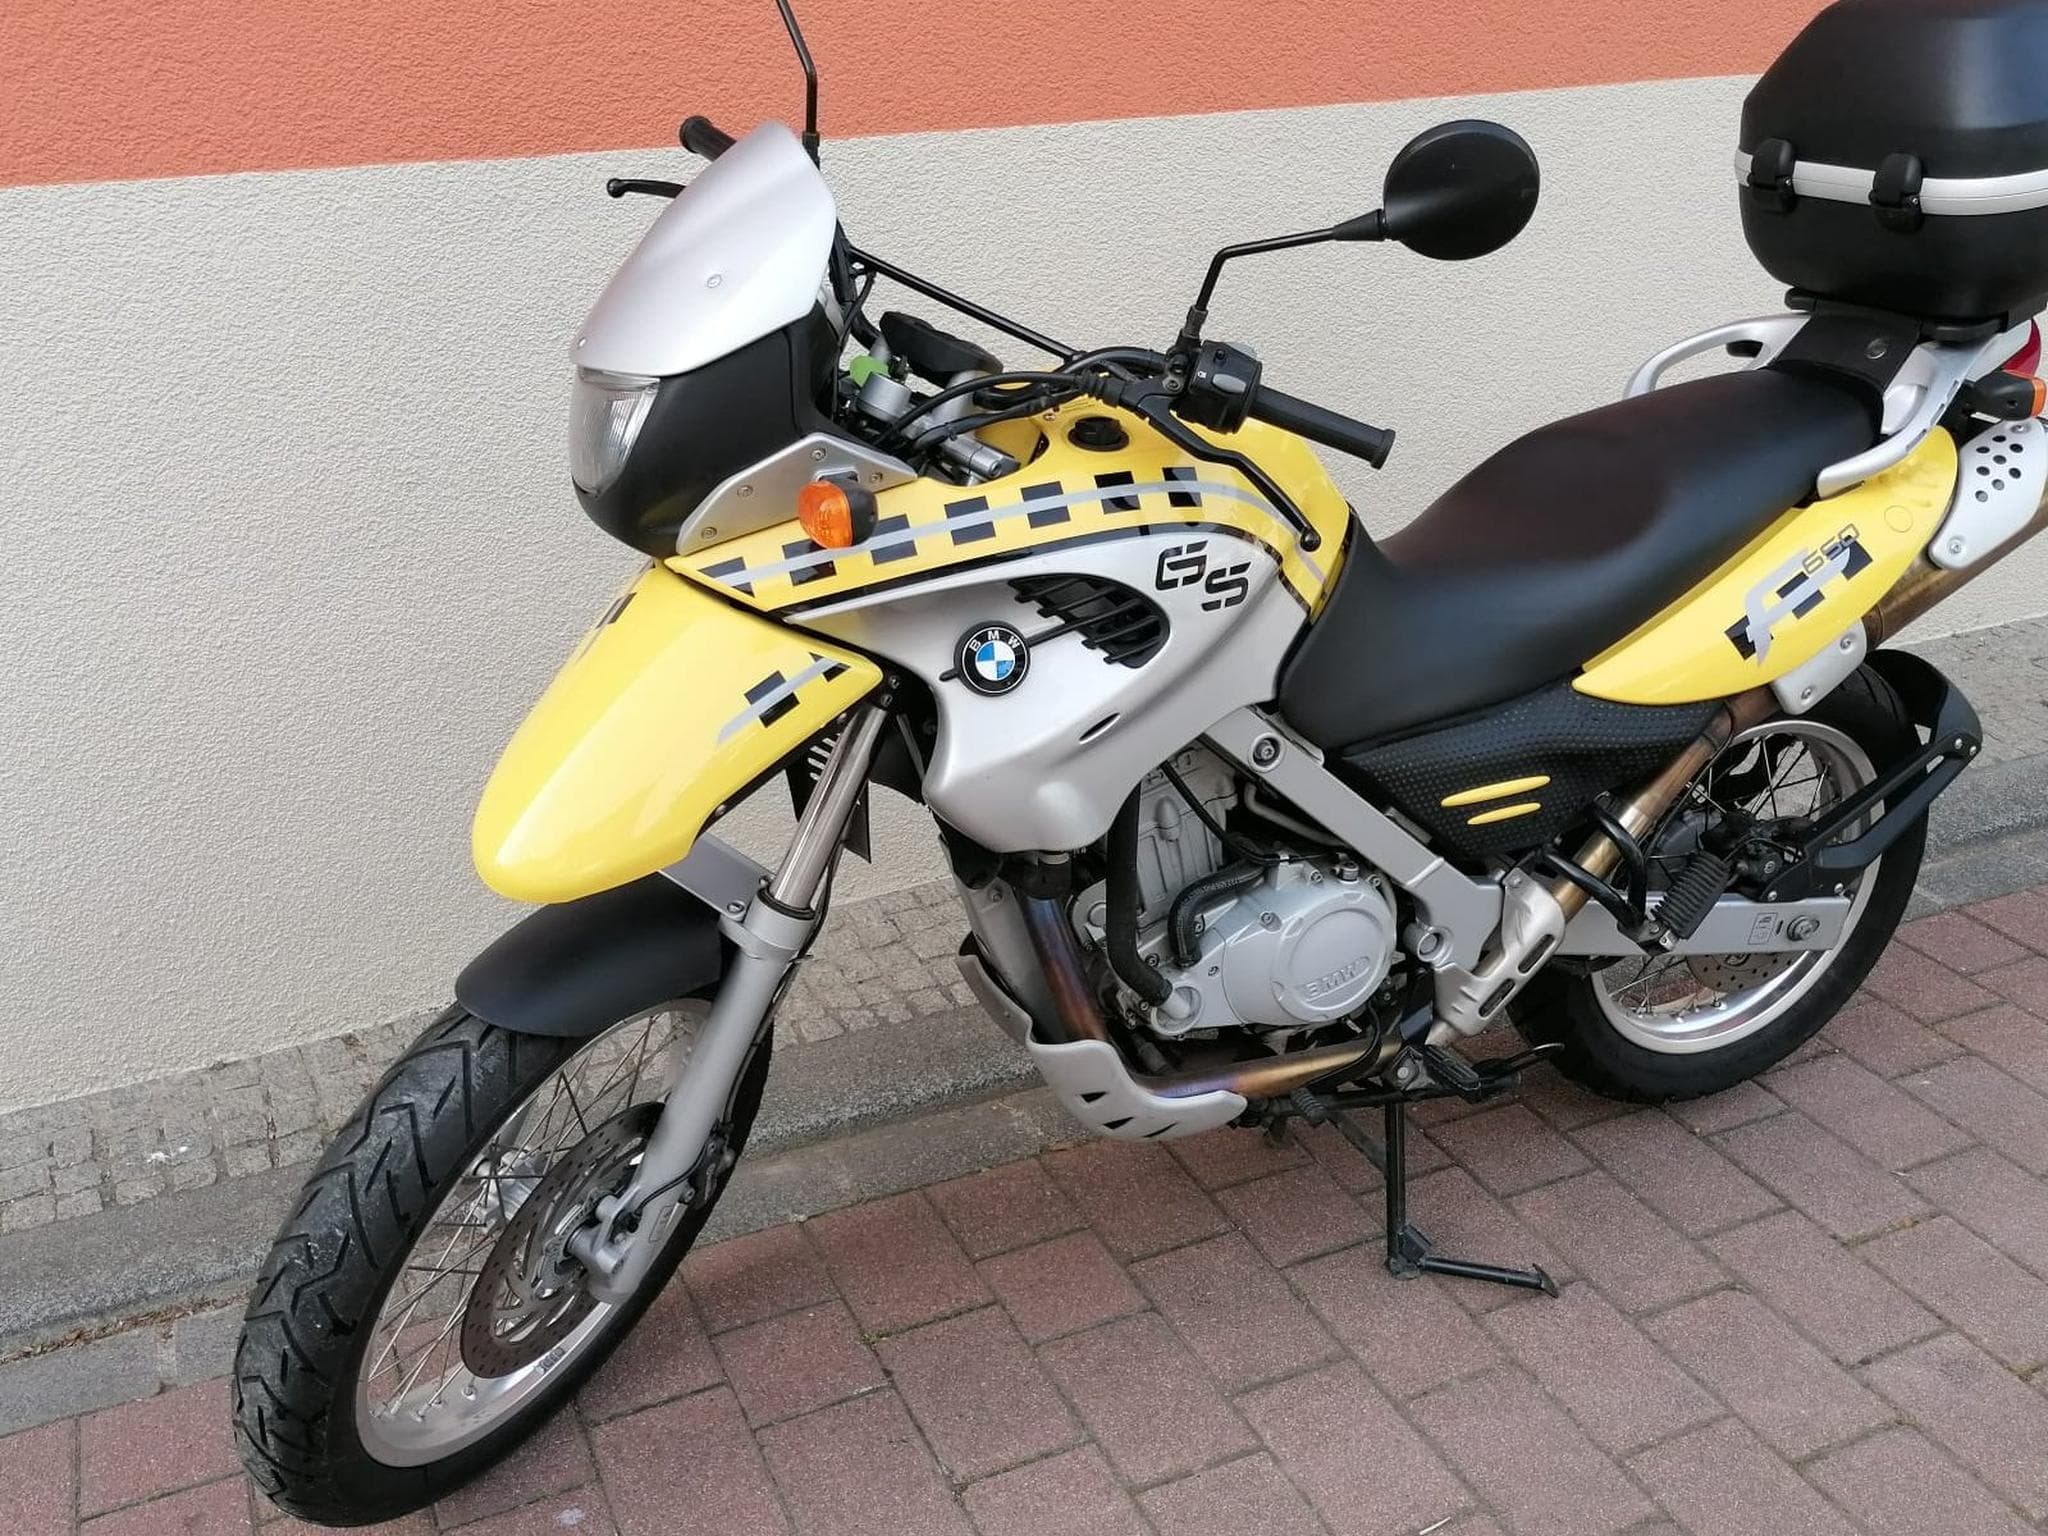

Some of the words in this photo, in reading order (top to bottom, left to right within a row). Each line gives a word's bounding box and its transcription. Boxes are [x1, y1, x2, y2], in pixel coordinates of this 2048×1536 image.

[1802, 523, 1860, 575] 650
[1155, 541, 1251, 611] GS
[968, 629, 1021, 652] BMW
[1305, 957, 1366, 997] BMW
